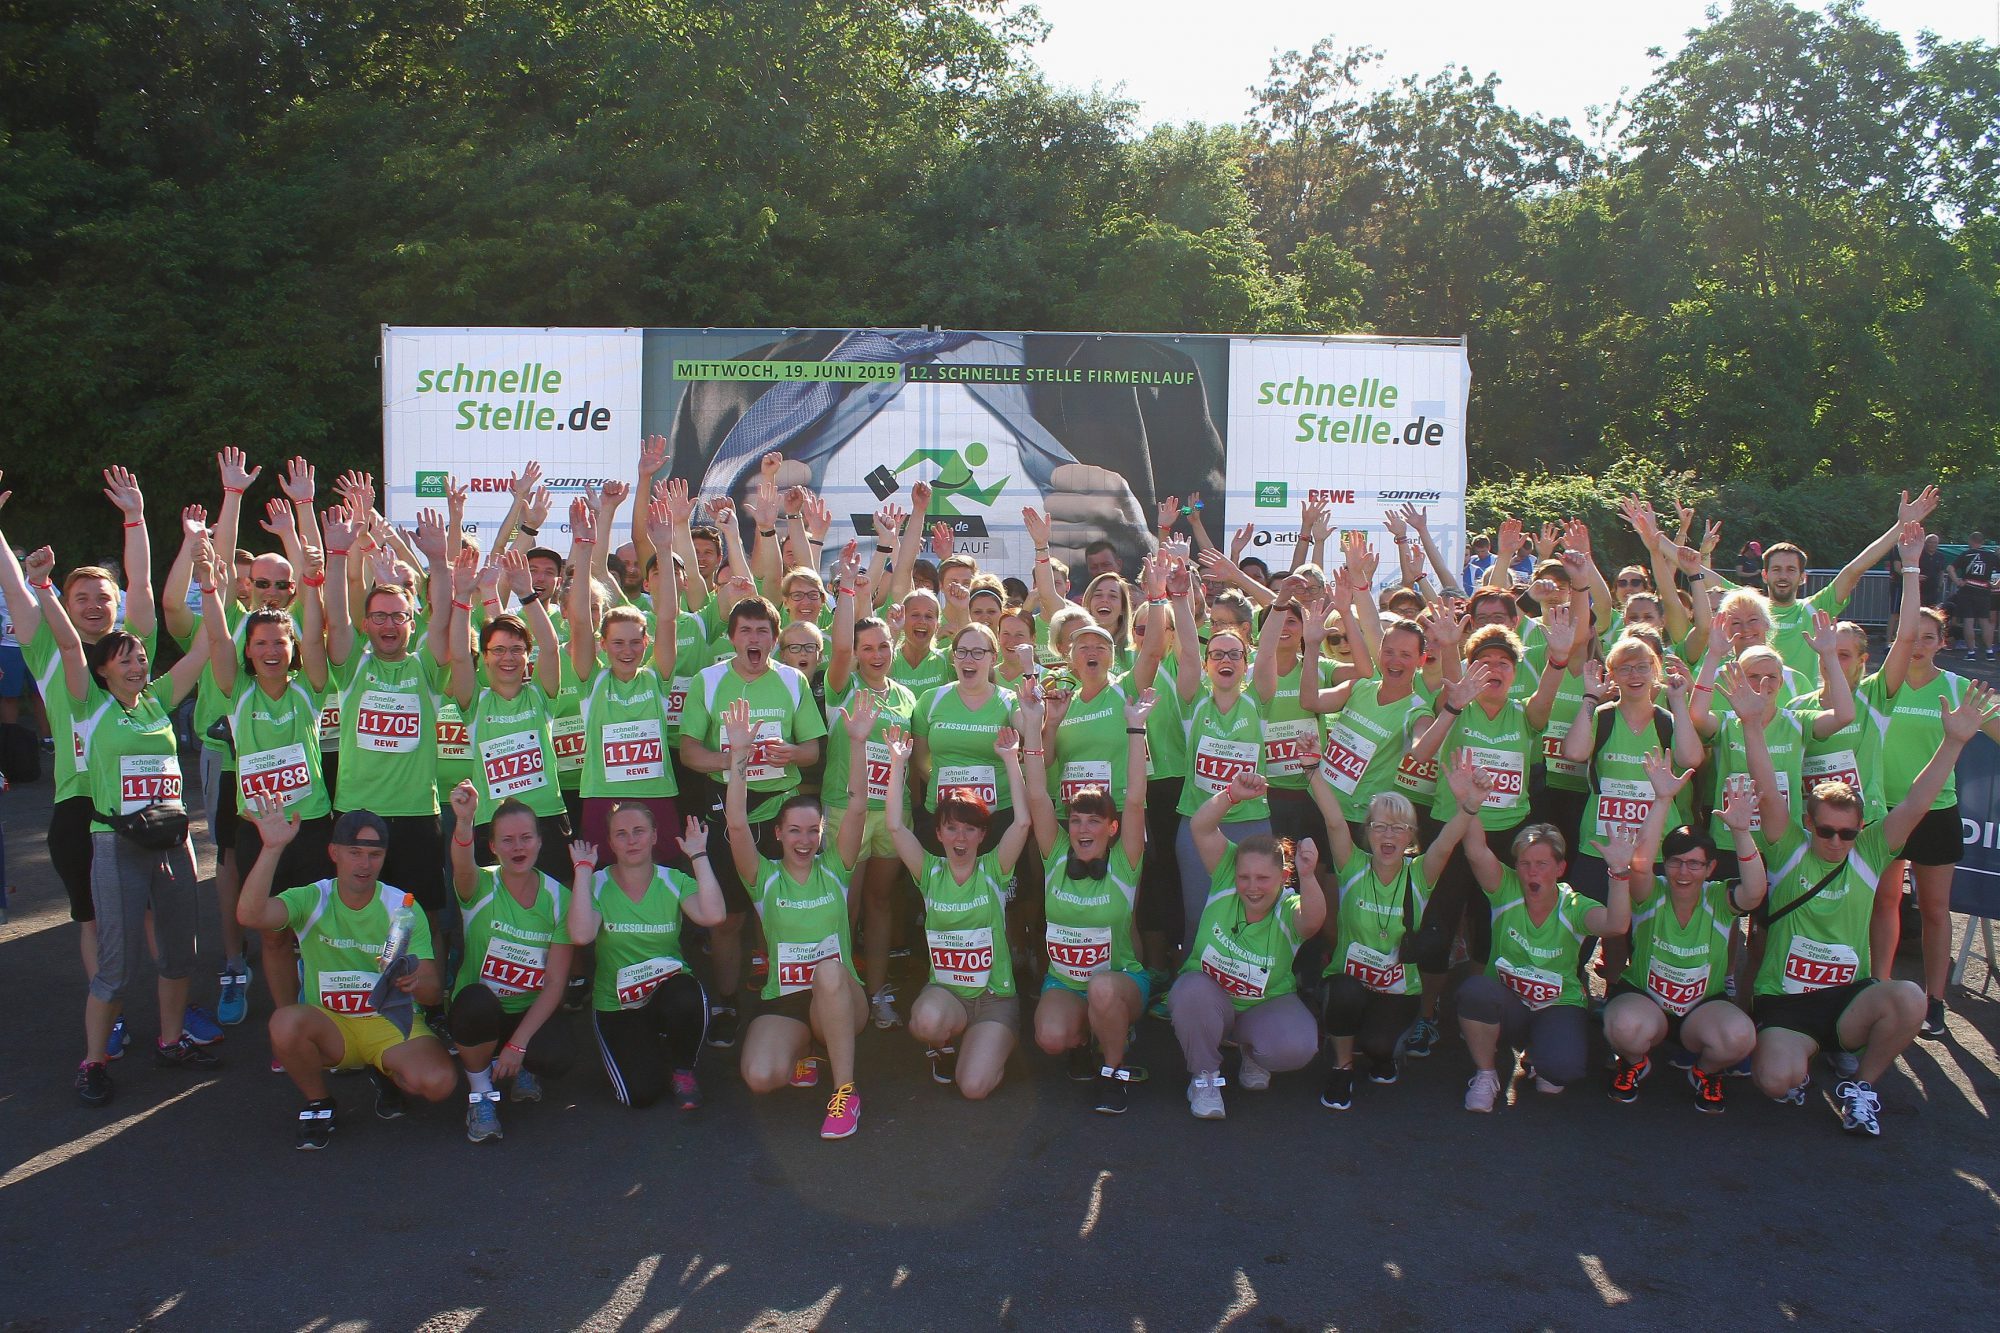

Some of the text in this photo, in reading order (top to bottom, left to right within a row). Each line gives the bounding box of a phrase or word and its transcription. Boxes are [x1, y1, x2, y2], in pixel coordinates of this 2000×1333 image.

[416, 363, 562, 393] schnelle
[678, 364, 896, 379] MITTWOCH, 19. JUNI 2019
[910, 367, 1194, 385] 12. SCHNELLE STELLE FIRMENLAUF
[1257, 376, 1398, 408] schnelle
[455, 400, 611, 431] Stelle.de
[1295, 413, 1444, 446] Stelle.de
[471, 478, 514, 492] REW
[1308, 489, 1355, 503] REWE
[359, 713, 418, 734] 11705
[374, 739, 399, 747] REWE
[443, 747, 465, 755] REWE
[606, 741, 661, 764] 11747
[487, 751, 542, 781] 11736
[1324, 742, 1364, 778] 11744
[243, 766, 309, 796] 11788
[626, 767, 650, 776] REWE
[747, 769, 765, 777] EWE
[124, 778, 181, 798] 11780
[508, 779, 532, 790] REWE
[500, 944, 531, 957] schnelle
[506, 953, 538, 966] Stelle.de
[933, 950, 992, 970] 11706
[1050, 945, 1110, 965] 11734
[953, 974, 975, 982] REWE
[1069, 969, 1092, 977] REWE
[1347, 963, 1403, 986] 11795
[1787, 959, 1854, 983] 11715
[1649, 974, 1704, 1002] 11791
